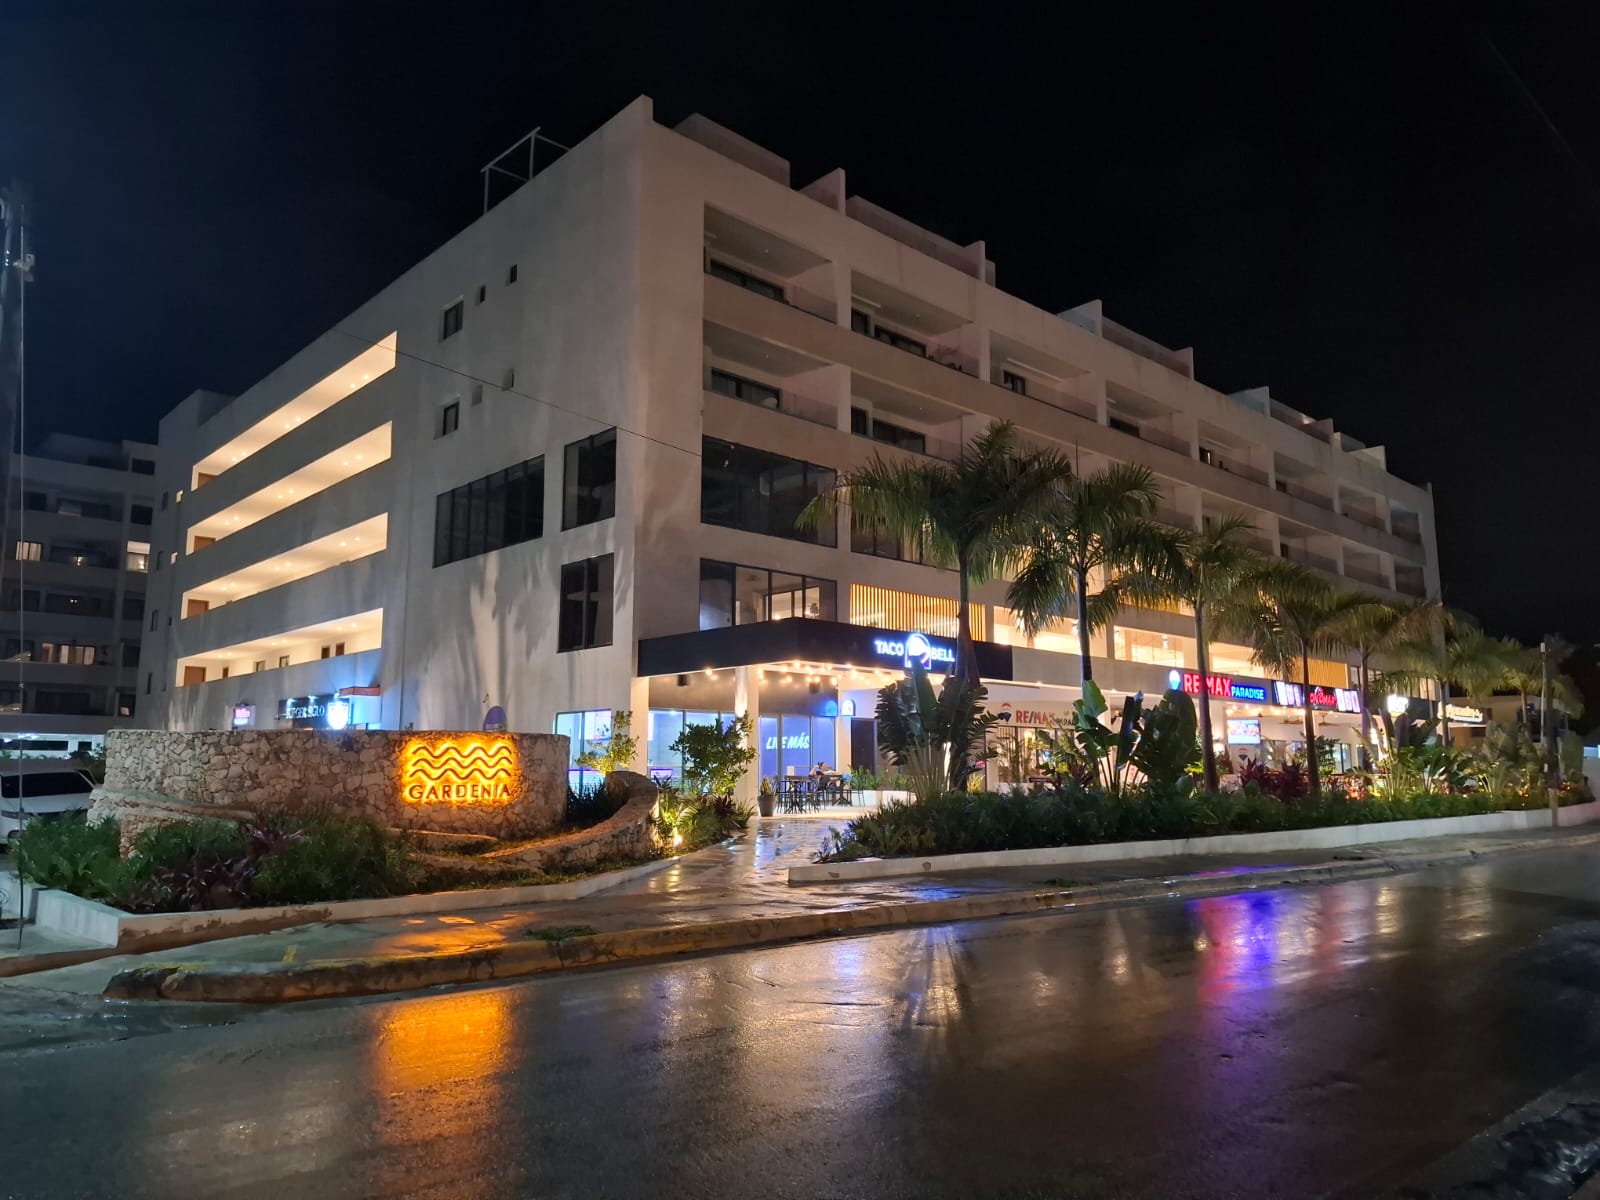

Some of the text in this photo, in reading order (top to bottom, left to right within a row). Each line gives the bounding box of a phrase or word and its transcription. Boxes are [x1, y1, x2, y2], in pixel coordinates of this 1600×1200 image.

[874, 640, 955, 662] TACO BELL
[1183, 673, 1265, 700] REMAX PARADISE
[408, 784, 511, 800] GARDENIA
